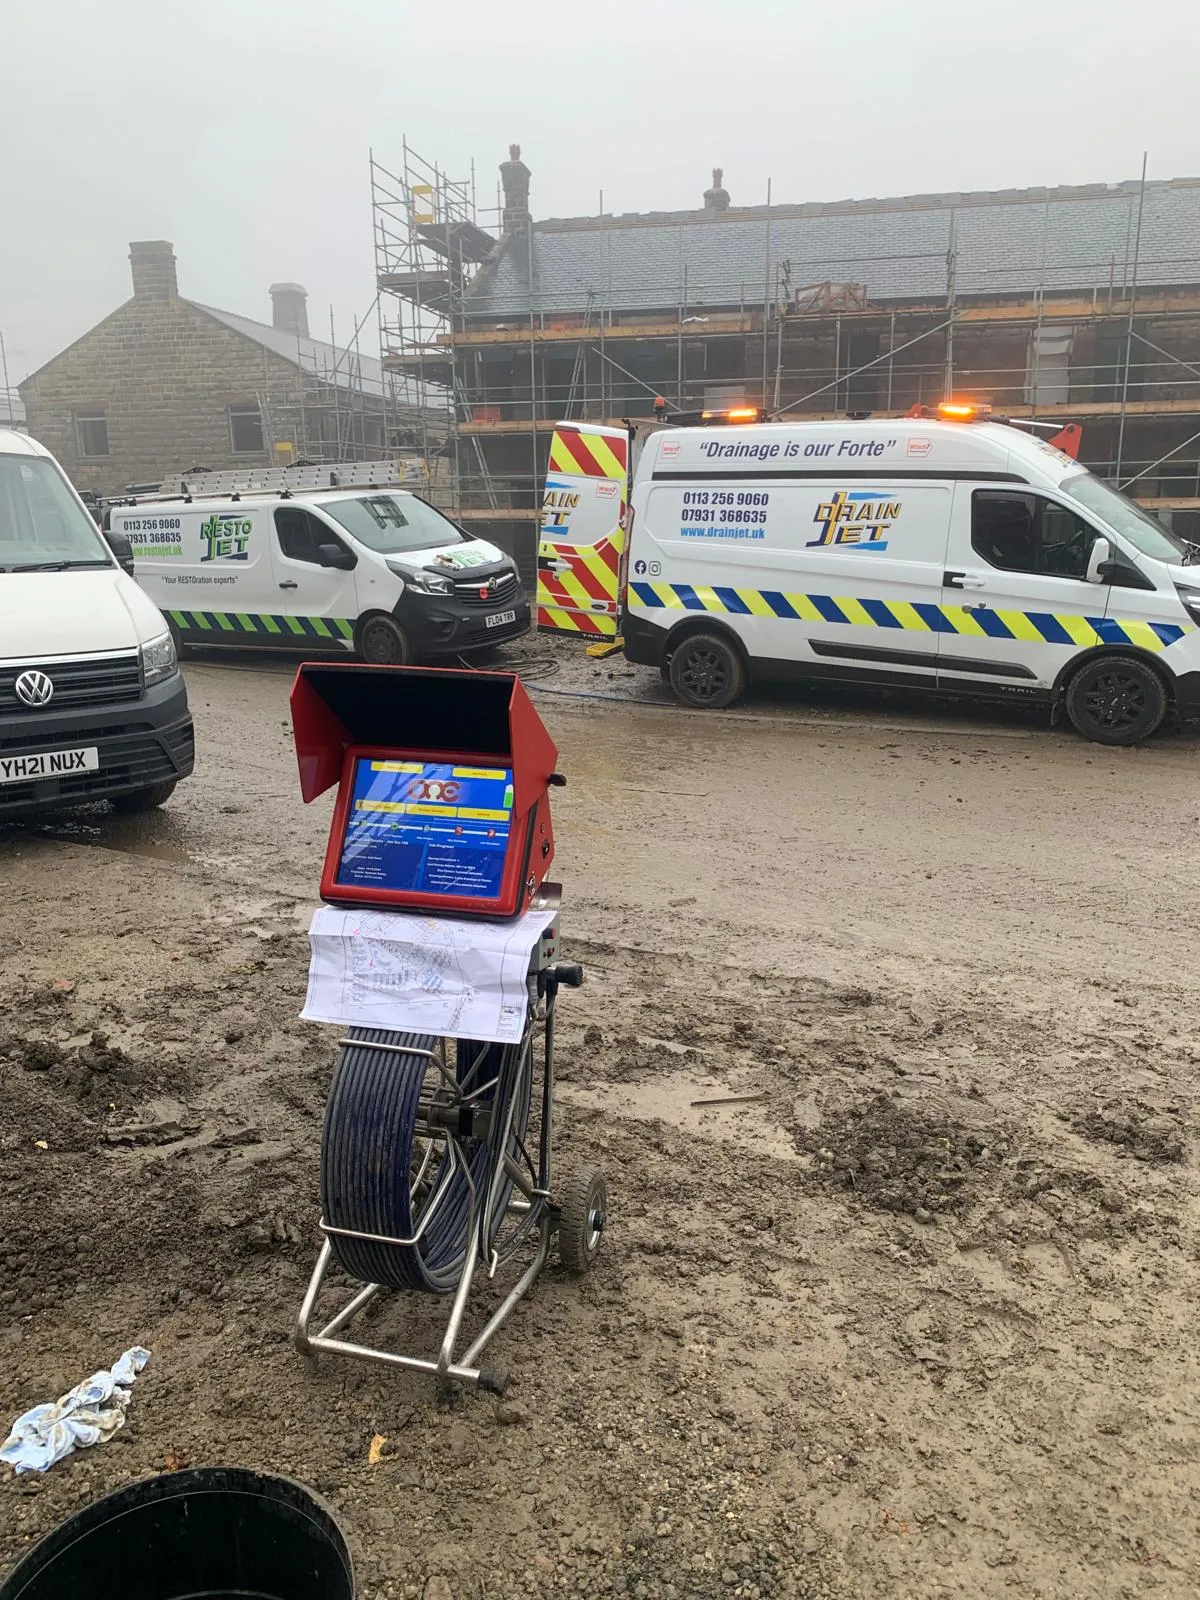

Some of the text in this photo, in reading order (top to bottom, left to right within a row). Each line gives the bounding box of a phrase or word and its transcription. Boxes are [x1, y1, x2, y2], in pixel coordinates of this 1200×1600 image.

[700, 439, 897, 460] “Drainage is our Forte”
[683, 491, 769, 506] 0113 256 9060
[681, 508, 768, 524] 07931 368635
[813, 502, 903, 523] DRAIN
[123, 518, 181, 531] 0113 256 9060
[200, 519, 253, 540] RESTO
[125, 531, 182, 544] 7931 368635
[680, 526, 766, 540] www.drainjet.uk
[999, 686, 1037, 694] TRAIL
[0, 751, 87, 778] YH21 NUX
